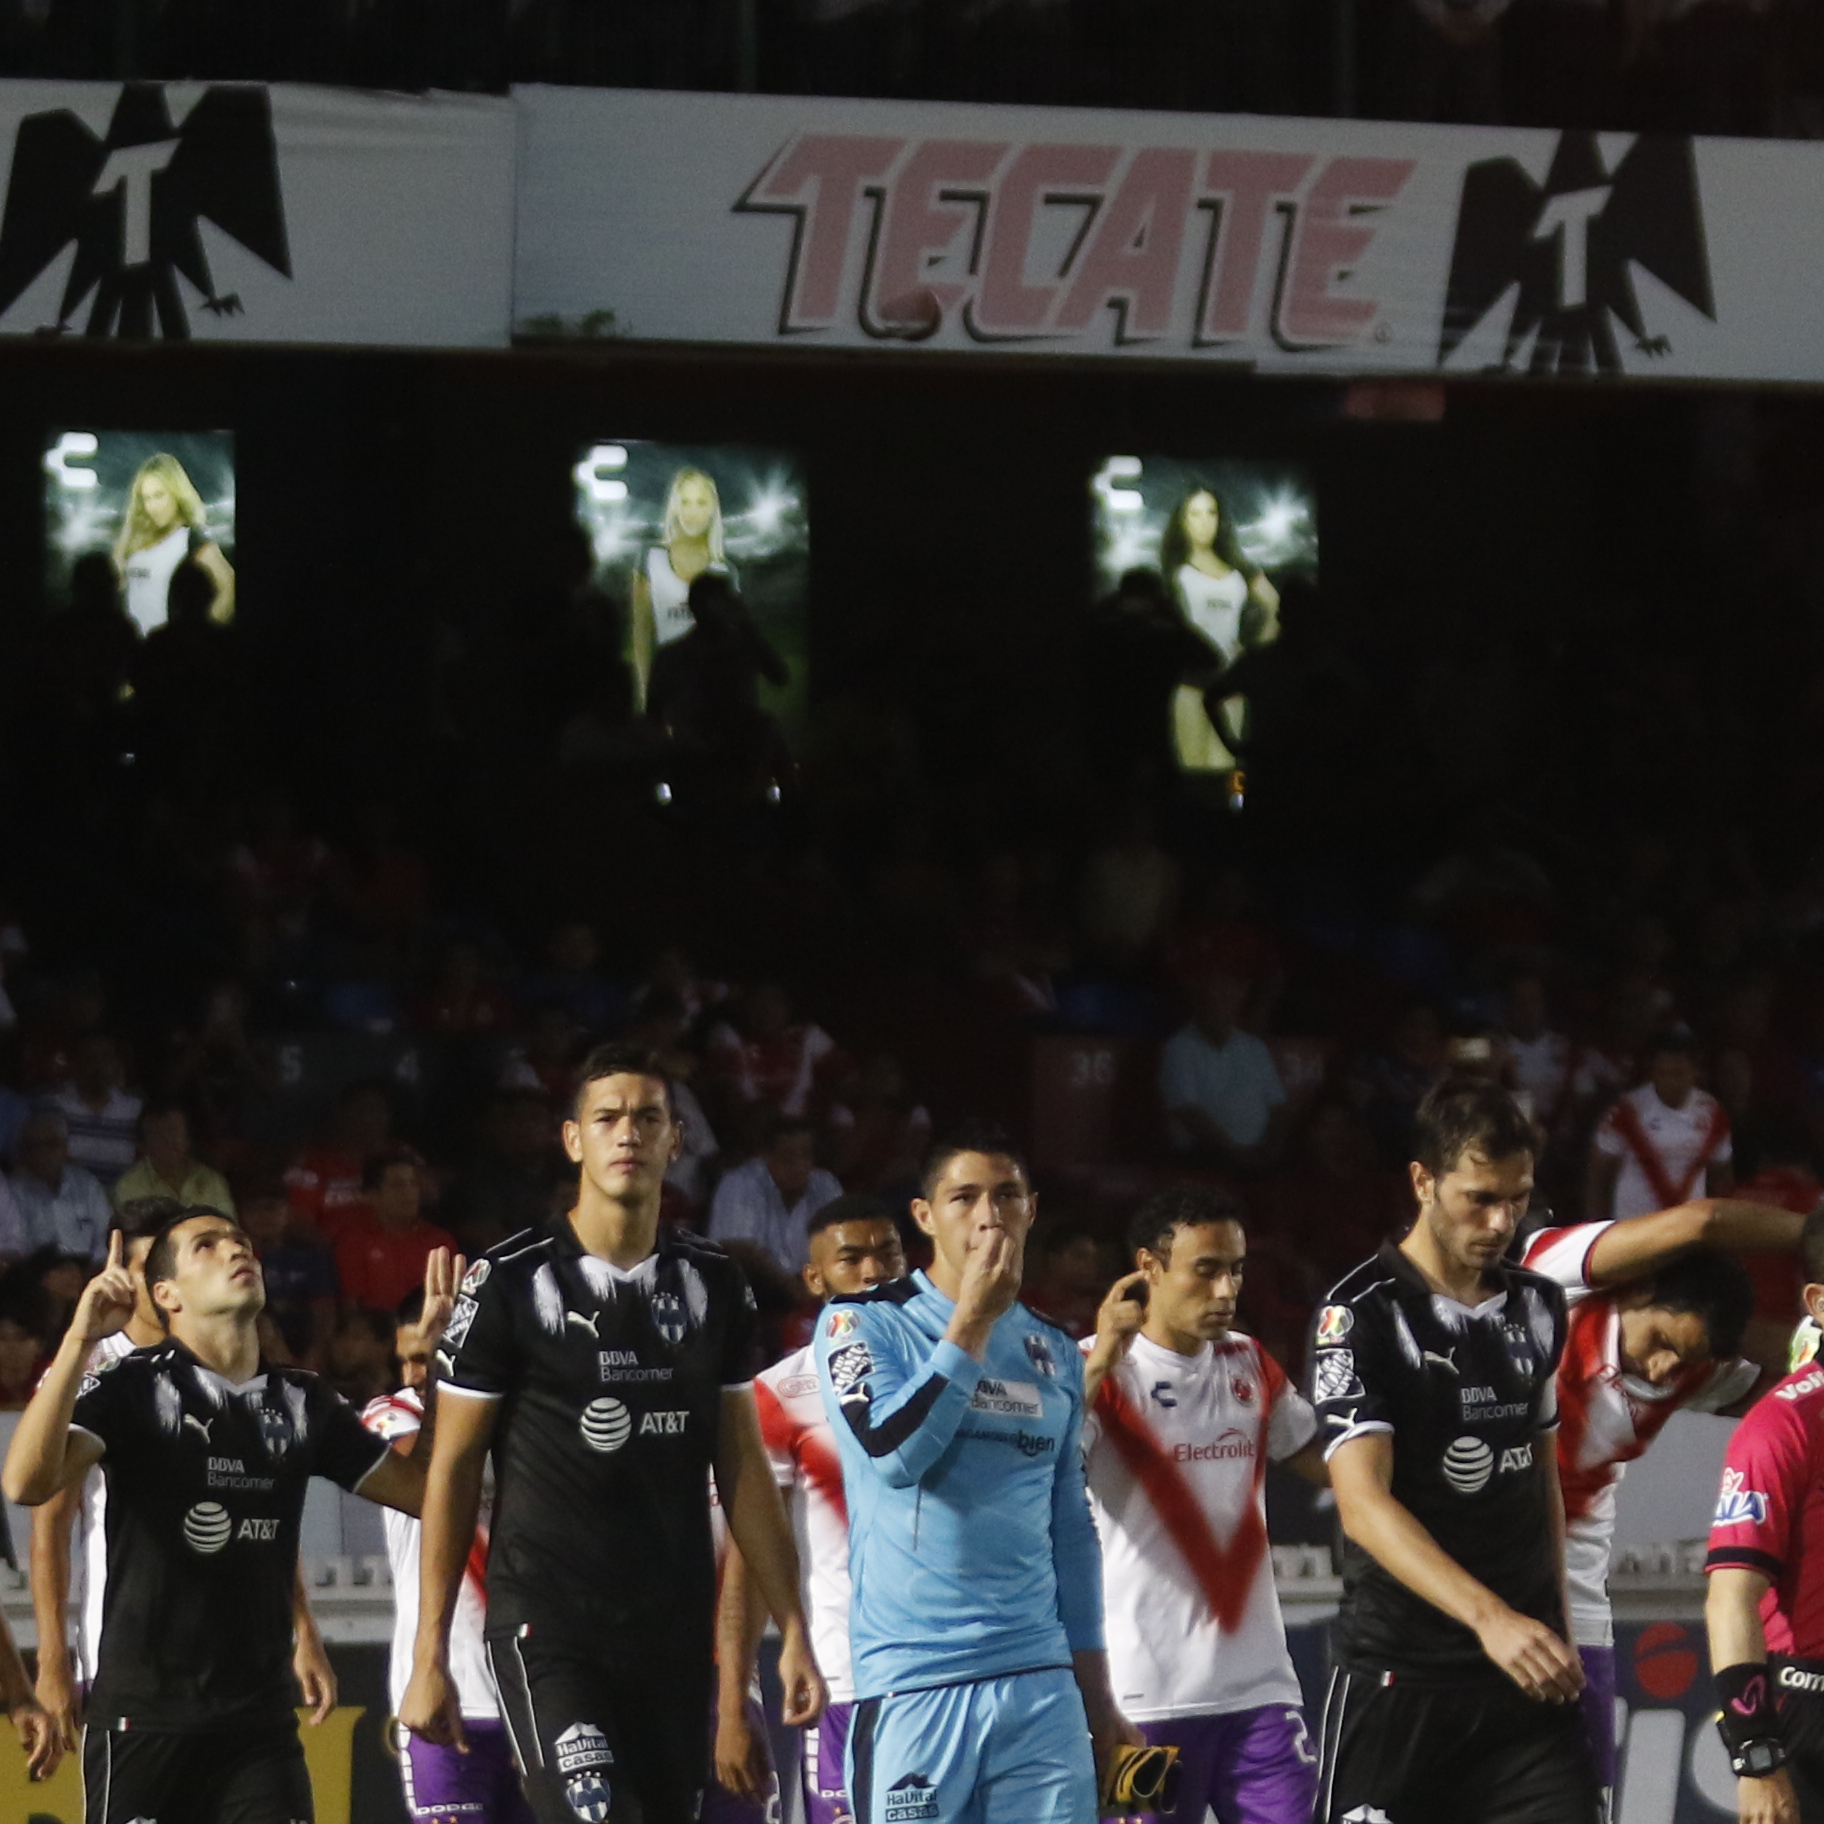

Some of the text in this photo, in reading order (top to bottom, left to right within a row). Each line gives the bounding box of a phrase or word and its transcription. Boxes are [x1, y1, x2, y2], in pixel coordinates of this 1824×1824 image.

[732, 132, 1418, 352] TECATE
[598, 1350, 639, 1366] BBVA
[600, 1364, 675, 1382] Bancomer
[1461, 1385, 1499, 1404] BBVA
[1462, 1401, 1530, 1422] Bancomer
[639, 1410, 690, 1435] AT&T
[1175, 1441, 1256, 1463] Electrolit
[207, 1456, 245, 1471] BBVA
[207, 1470, 275, 1489] Bancomer
[238, 1518, 281, 1540] AT&T
[558, 1748, 614, 1774] casas
[885, 1787, 938, 1807] HaVital
[885, 1804, 939, 1823] casas
